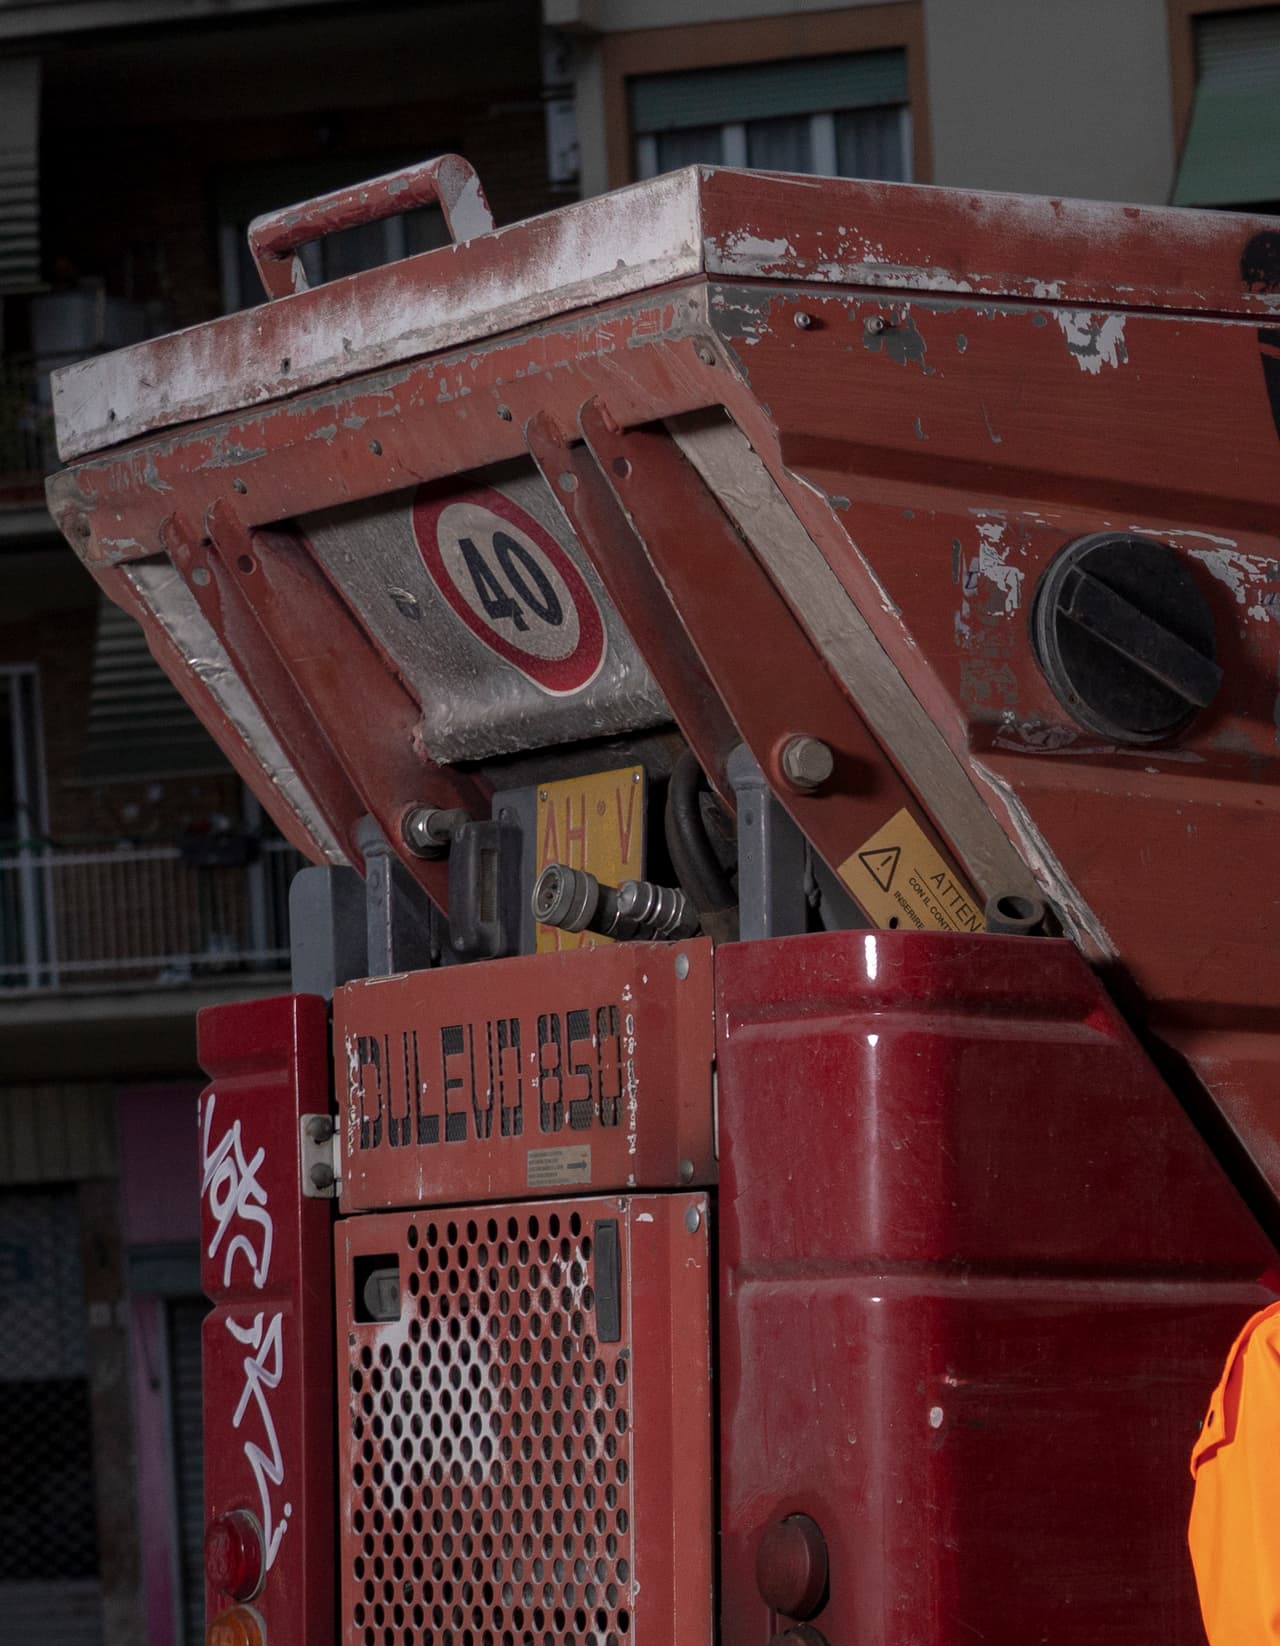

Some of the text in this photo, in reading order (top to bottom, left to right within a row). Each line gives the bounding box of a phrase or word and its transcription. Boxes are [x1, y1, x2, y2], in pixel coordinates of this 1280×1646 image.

[458, 530, 563, 632] 40
[930, 872, 985, 932] ATTEN
[537, 1005, 623, 1132] 850
